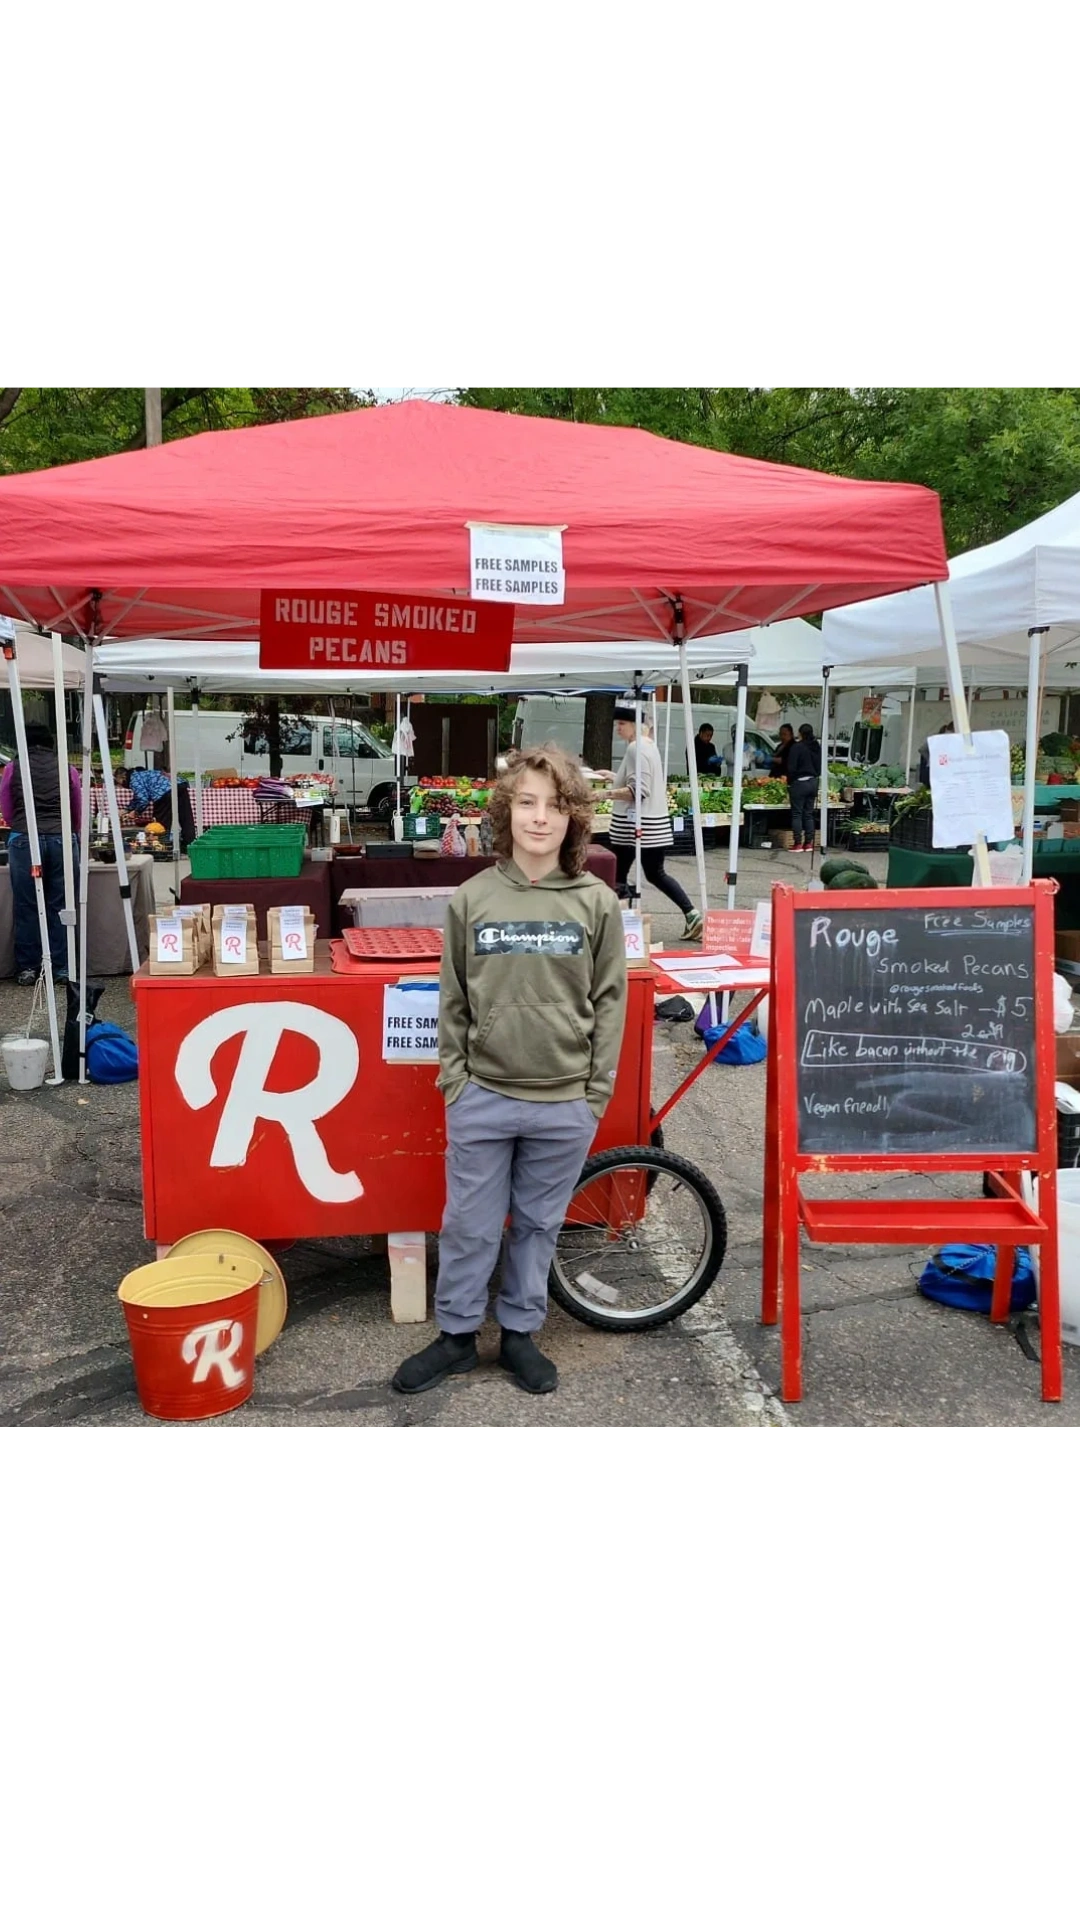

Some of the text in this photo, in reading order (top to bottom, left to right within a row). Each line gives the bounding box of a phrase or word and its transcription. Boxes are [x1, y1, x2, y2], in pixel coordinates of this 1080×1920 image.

[475, 558, 558, 574] FREE SAMPLES
[475, 578, 559, 595] FREE SAMPLES
[275, 598, 477, 634] ROUGE SMOKED
[309, 637, 407, 664] PECANS
[924, 911, 1031, 932] Free Samples
[162, 933, 178, 953] R
[225, 936, 241, 956] R
[285, 933, 302, 951] R
[479, 928, 580, 947] Champion
[810, 916, 899, 957] Rouge
[877, 955, 1029, 979] Smoked Pecans
[804, 996, 863, 1023] Maple
[870, 997, 902, 1015] with
[387, 1016, 439, 1029] FREE SAM
[961, 1023, 975, 1038] 2
[387, 1036, 439, 1049] FREE SAM
[806, 1034, 849, 1059] Like
[856, 1034, 899, 1058] bacon
[953, 1044, 977, 1060] the
[986, 1049, 1016, 1073] pig
[174, 1001, 364, 1203] R
[803, 1093, 840, 1119] Vegan
[181, 1319, 247, 1389] R
